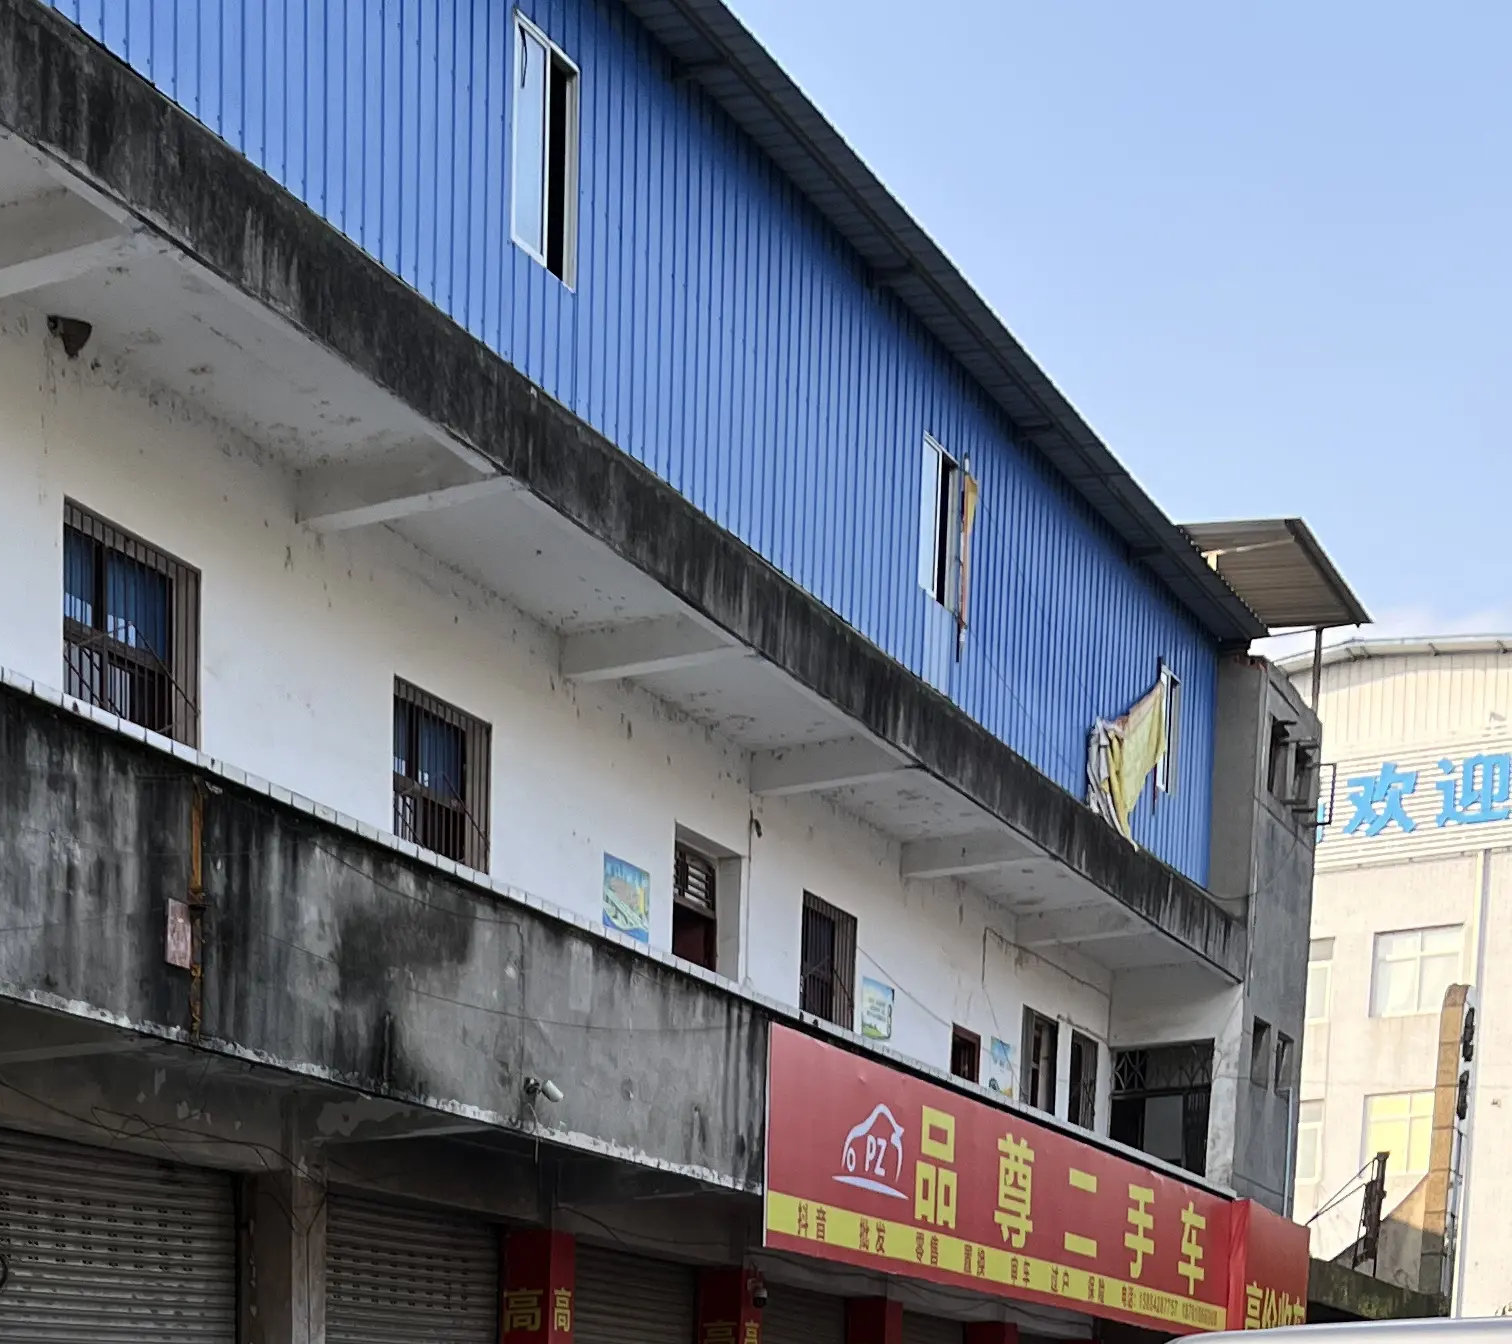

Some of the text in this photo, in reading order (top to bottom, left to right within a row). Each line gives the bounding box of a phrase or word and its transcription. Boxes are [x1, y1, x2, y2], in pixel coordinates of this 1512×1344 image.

[1317, 753, 1512, 842] 欢迎
[914, 1105, 1208, 1296] 品尊二手车
[797, 1202, 827, 1241] 抖音
[859, 1216, 885, 1254] 批发
[915, 1232, 938, 1266] 零售
[1050, 1265, 1069, 1292] 过户
